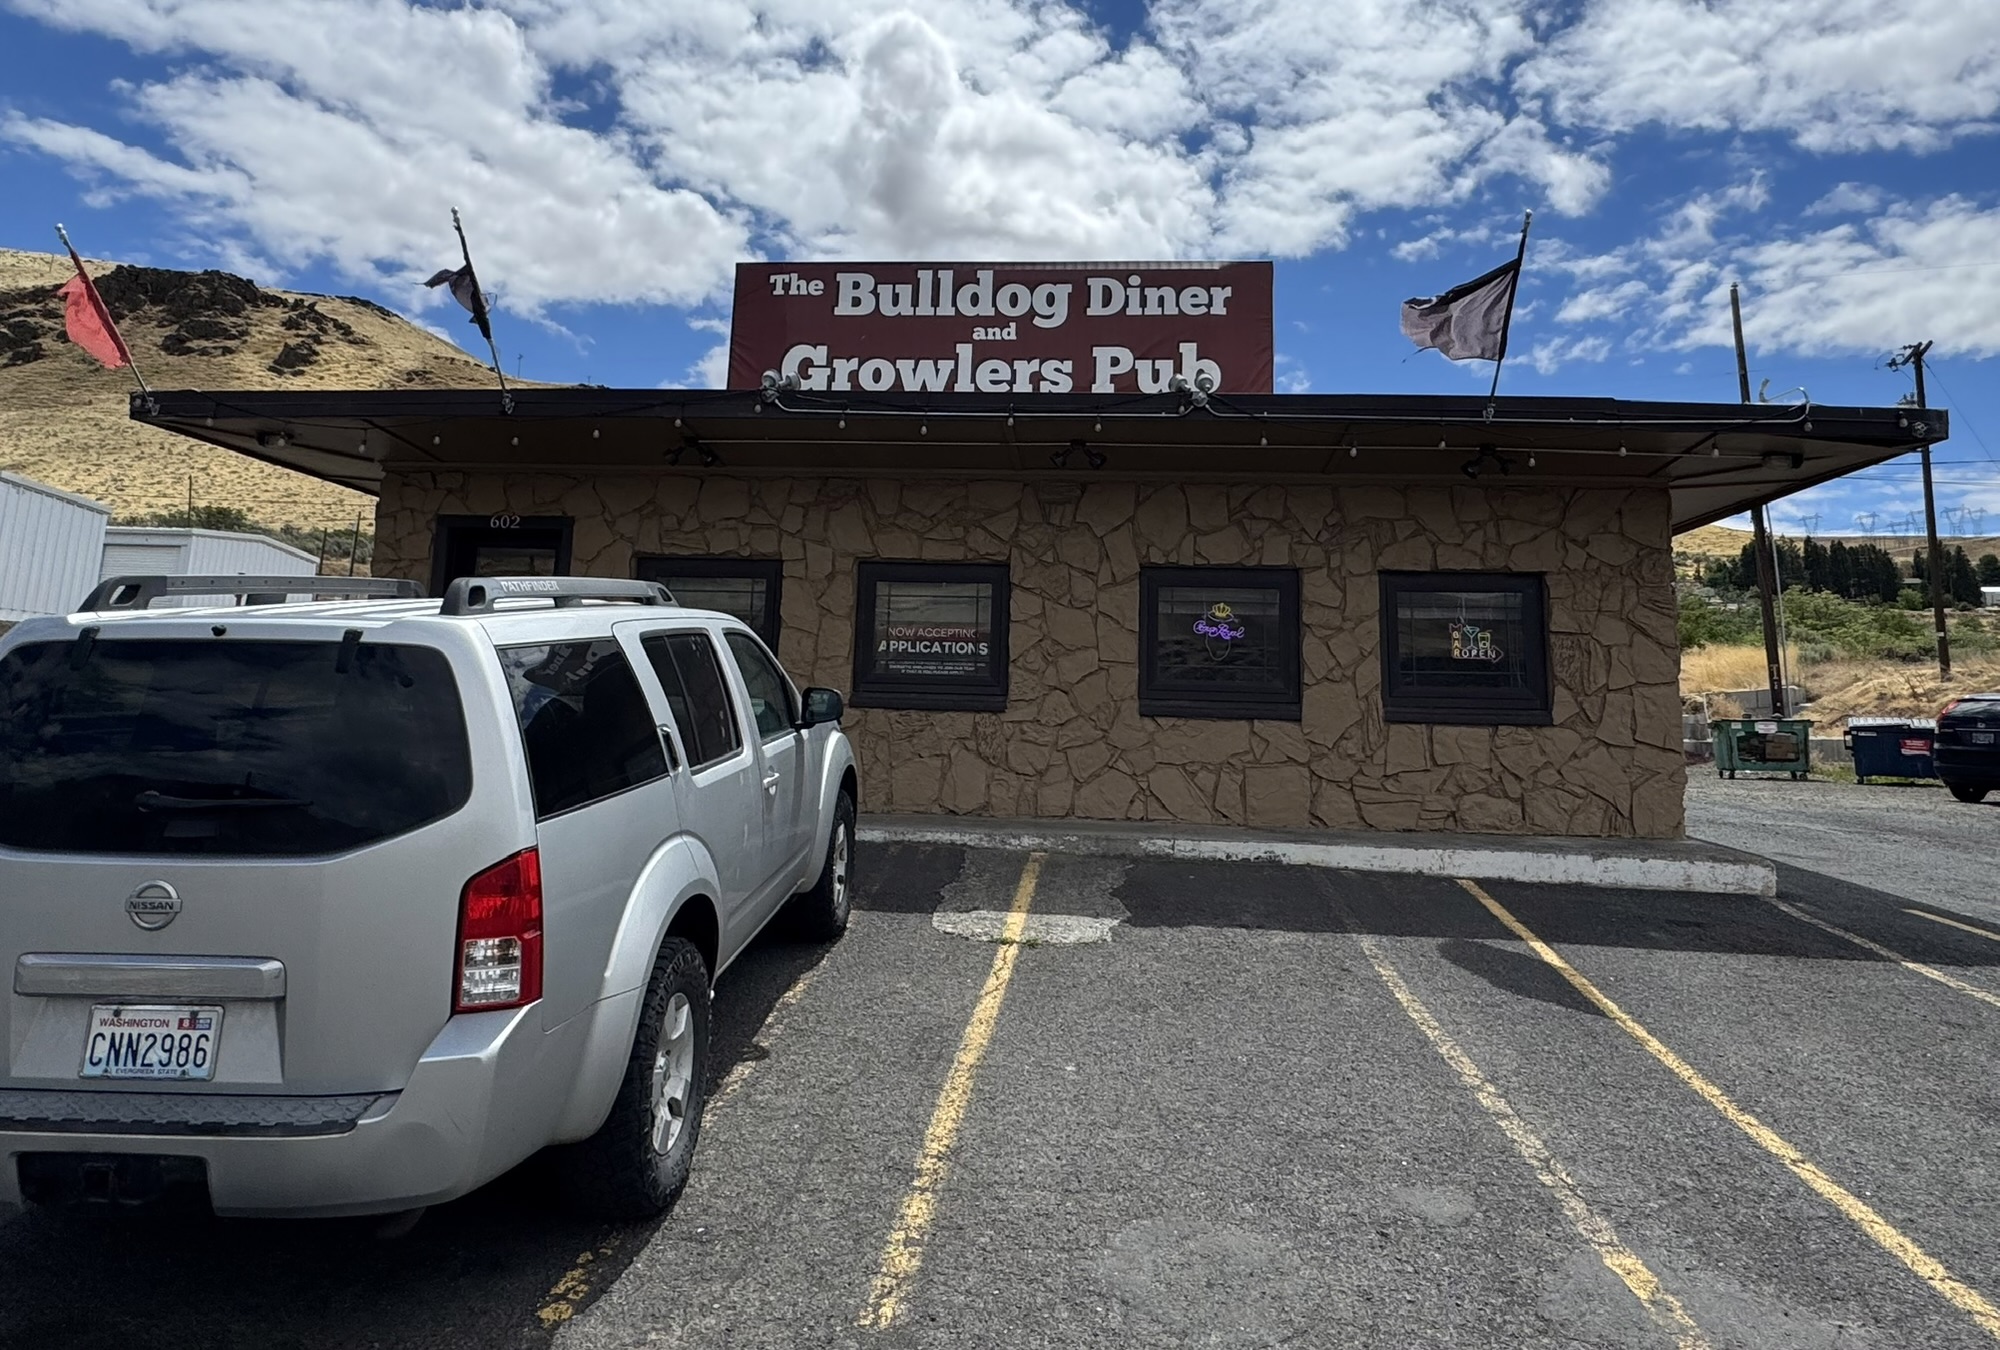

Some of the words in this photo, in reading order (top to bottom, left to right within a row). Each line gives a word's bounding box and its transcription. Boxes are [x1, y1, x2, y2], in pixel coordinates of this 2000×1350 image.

[770, 273, 825, 297] The
[834, 269, 1072, 329] Bulldog
[1086, 274, 1232, 316] Diner
[973, 322, 1017, 341] and
[781, 343, 1073, 393] Growlers
[1091, 342, 1222, 394] Pub
[490, 514, 521, 529] 602
[500, 580, 560, 592] PATHFINDER
[888, 627, 915, 637] NOW
[877, 640, 989, 656] APPLICATIONS
[1461, 649, 1497, 658] OPEN
[129, 901, 174, 910] NISSAN
[99, 1017, 170, 1028] WASHINGTON
[89, 1032, 210, 1068] CNN2986
[115, 1067, 155, 1075] EVERGREEN
[157, 1068, 178, 1076] STATE
